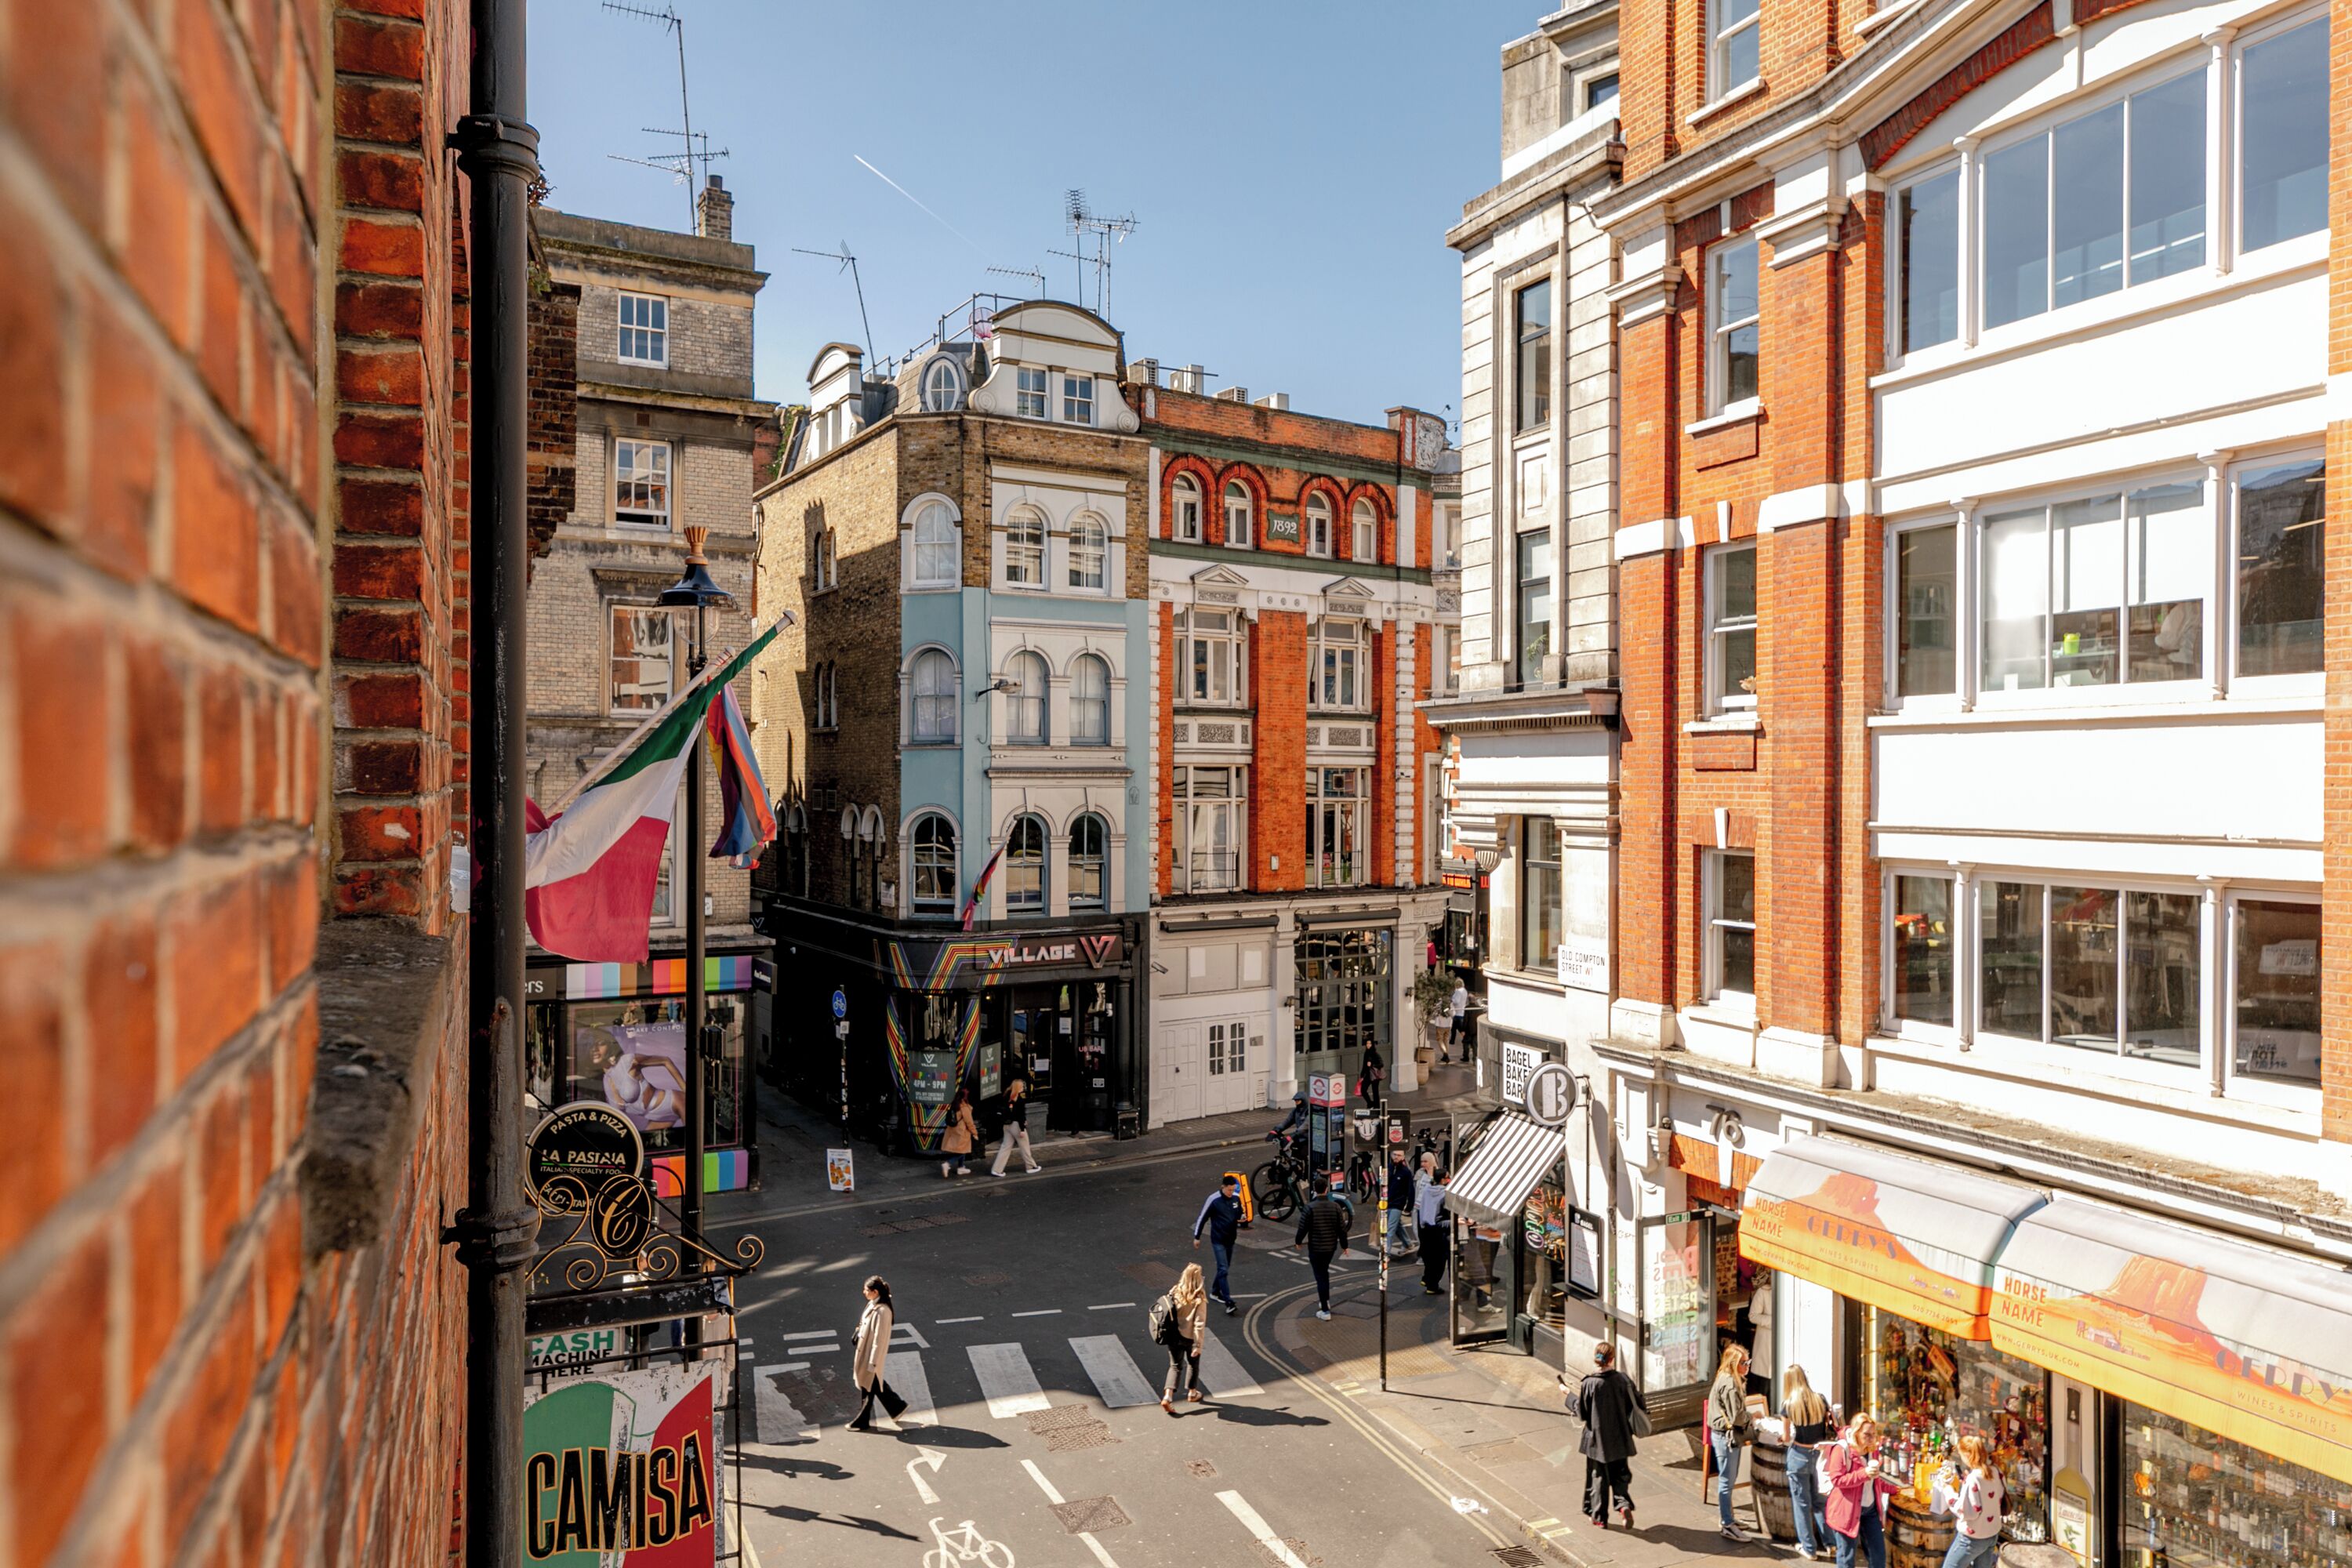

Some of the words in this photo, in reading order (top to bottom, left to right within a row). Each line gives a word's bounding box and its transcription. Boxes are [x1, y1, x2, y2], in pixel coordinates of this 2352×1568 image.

[1272, 519, 1297, 535] 1892
[989, 944, 1076, 964] VILLAGE
[1562, 949, 1572, 960] OLD
[1576, 953, 1605, 966] COMPTON
[1562, 961, 1582, 975] STREET
[1585, 967, 1593, 977] W1
[1506, 1047, 1532, 1069] BAGEL
[1506, 1064, 1531, 1082] BAKE
[1506, 1080, 1523, 1098] BAR
[1541, 1073, 1567, 1118] B
[550, 1112, 586, 1134] PASTA
[589, 1112, 597, 1120] &
[600, 1113, 628, 1138] PIZZA
[1706, 1105, 1742, 1143] 76
[542, 1149, 560, 1162] LA
[1755, 1196, 1788, 1218] HORSE
[1752, 1216, 1784, 1238] NAME
[1807, 1216, 1897, 1260] GERRY'S
[1819, 1247, 1842, 1260] WINES
[1849, 1256, 1879, 1272] SPIRITS
[2004, 1276, 2048, 1304] HORSE
[2002, 1300, 2045, 1327] NAME
[532, 1330, 614, 1356] CASH
[2216, 1348, 2352, 1406] GERRY'
[2238, 1391, 2274, 1410] WINES
[2278, 1405, 2285, 1414] &
[2289, 1409, 2337, 1432] SPIRITS
[525, 1429, 714, 1561] CAMISA
